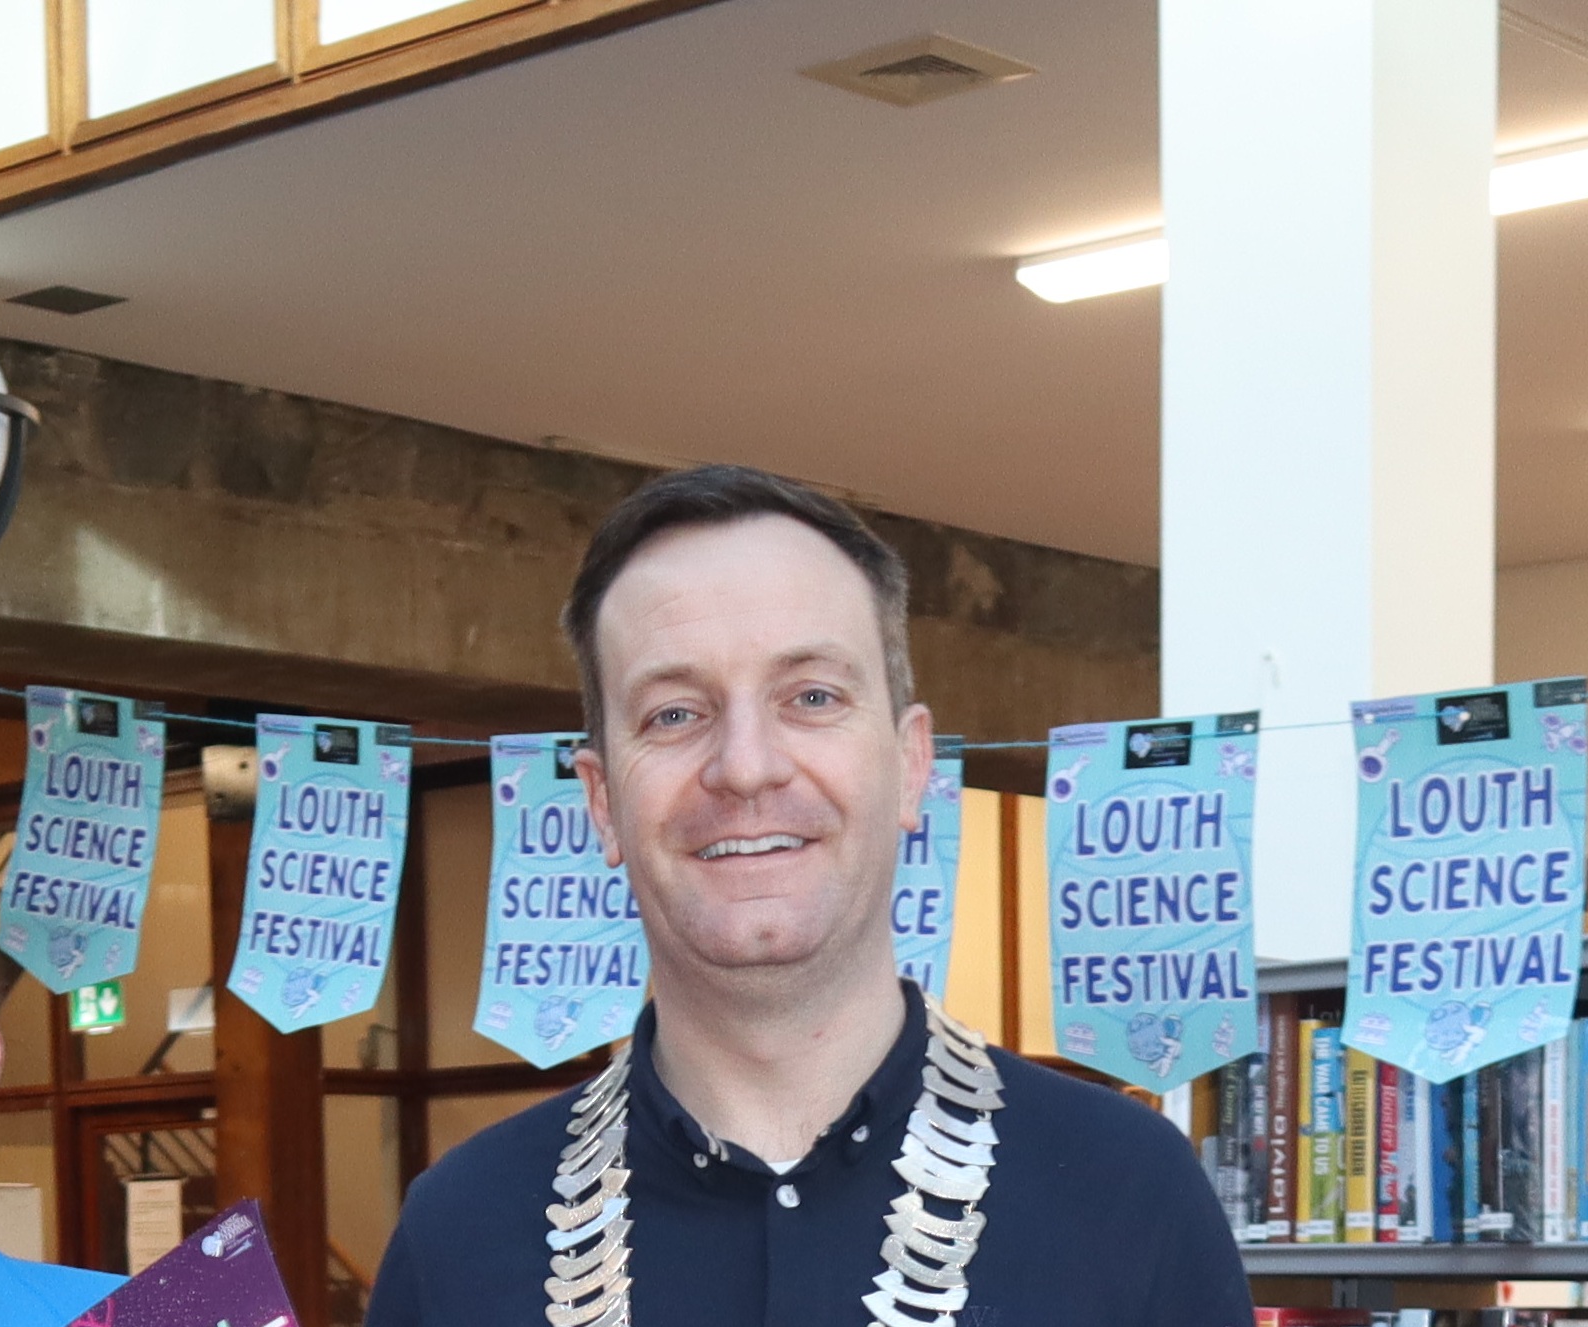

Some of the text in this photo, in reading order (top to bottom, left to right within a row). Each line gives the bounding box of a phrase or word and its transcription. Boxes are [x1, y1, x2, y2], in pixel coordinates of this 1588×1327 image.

[45, 755, 141, 808] LOUTH
[1389, 767, 1553, 838] LOUTH
[279, 785, 383, 839] LOUTH
[519, 807, 600, 854] LOU
[1075, 792, 1223, 855] LOUTH
[25, 815, 146, 867] SCIENCE
[11, 873, 137, 929] FESTIVAL
[259, 853, 390, 901] SCIENCE
[501, 877, 640, 920] SCIENCE
[1061, 872, 1240, 928] SCIENCE
[1369, 851, 1570, 916] SCIENCE
[250, 913, 381, 968] FESTIVAL
[495, 945, 641, 986] FESTIVAL
[1363, 933, 1571, 994] FESTIVAL
[1062, 952, 1249, 1004] FESTIVAL
[1313, 1037, 1332, 1175] THE WAR CAME TO US
[1380, 1086, 1398, 1147] Rooster
